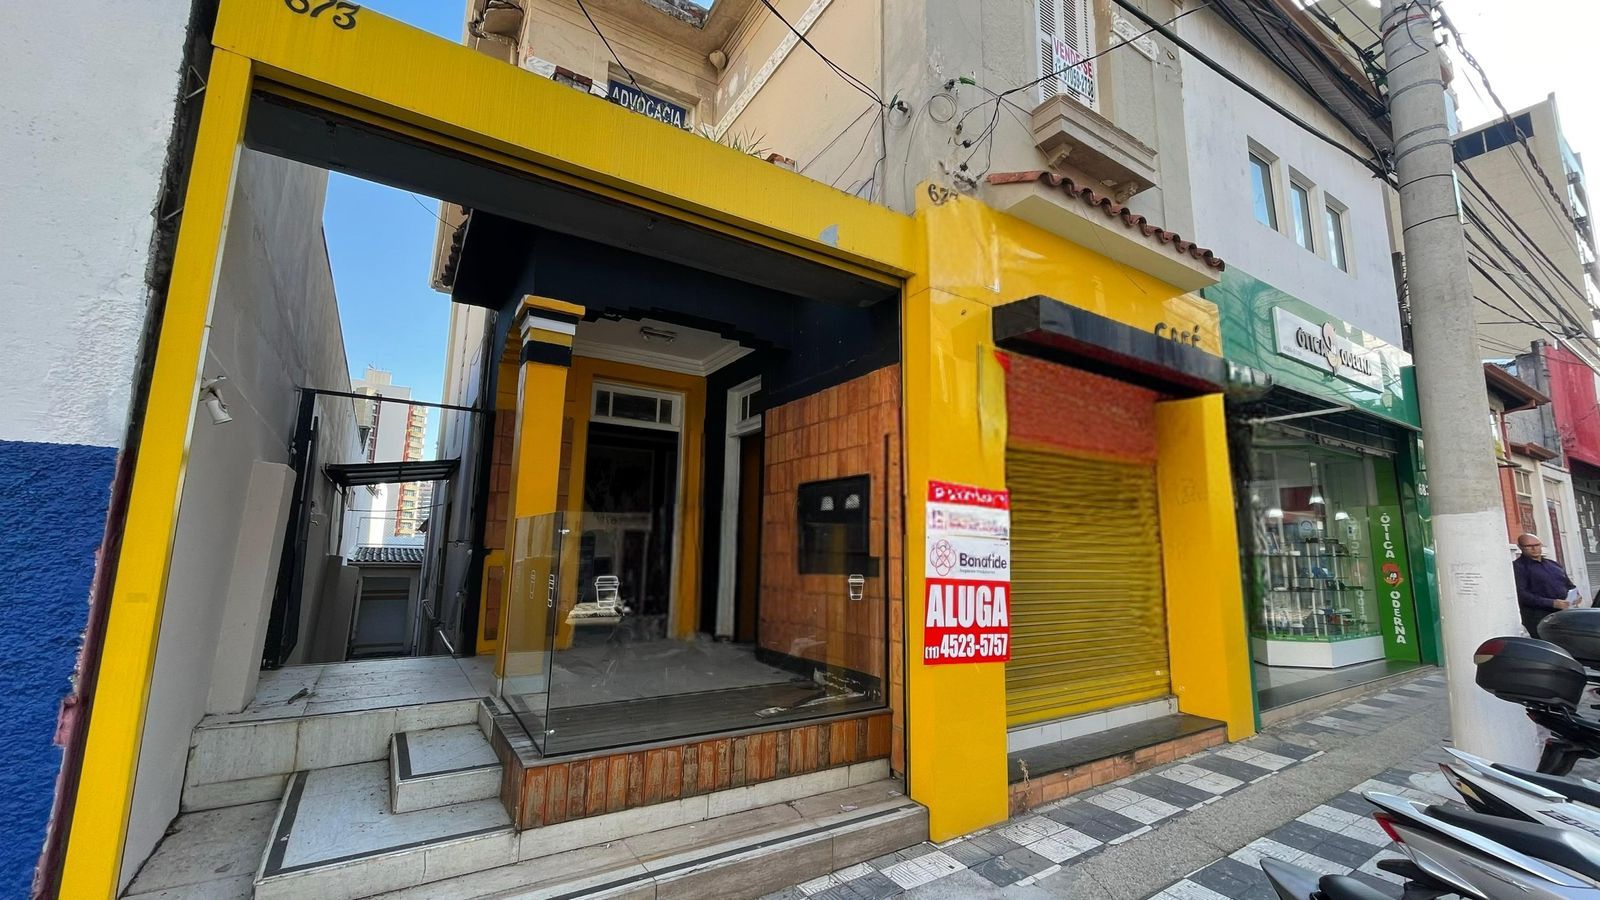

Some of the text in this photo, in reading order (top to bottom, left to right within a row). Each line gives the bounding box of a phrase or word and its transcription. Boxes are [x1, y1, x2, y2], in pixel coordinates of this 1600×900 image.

[612, 86, 682, 129] ADVOCACIA
[959, 552, 1007, 570] Bonafide
[926, 584, 1009, 629] ALUGA
[1390, 591, 1407, 645] ODERNA
[924, 633, 1009, 660] (11) 4523-5757
